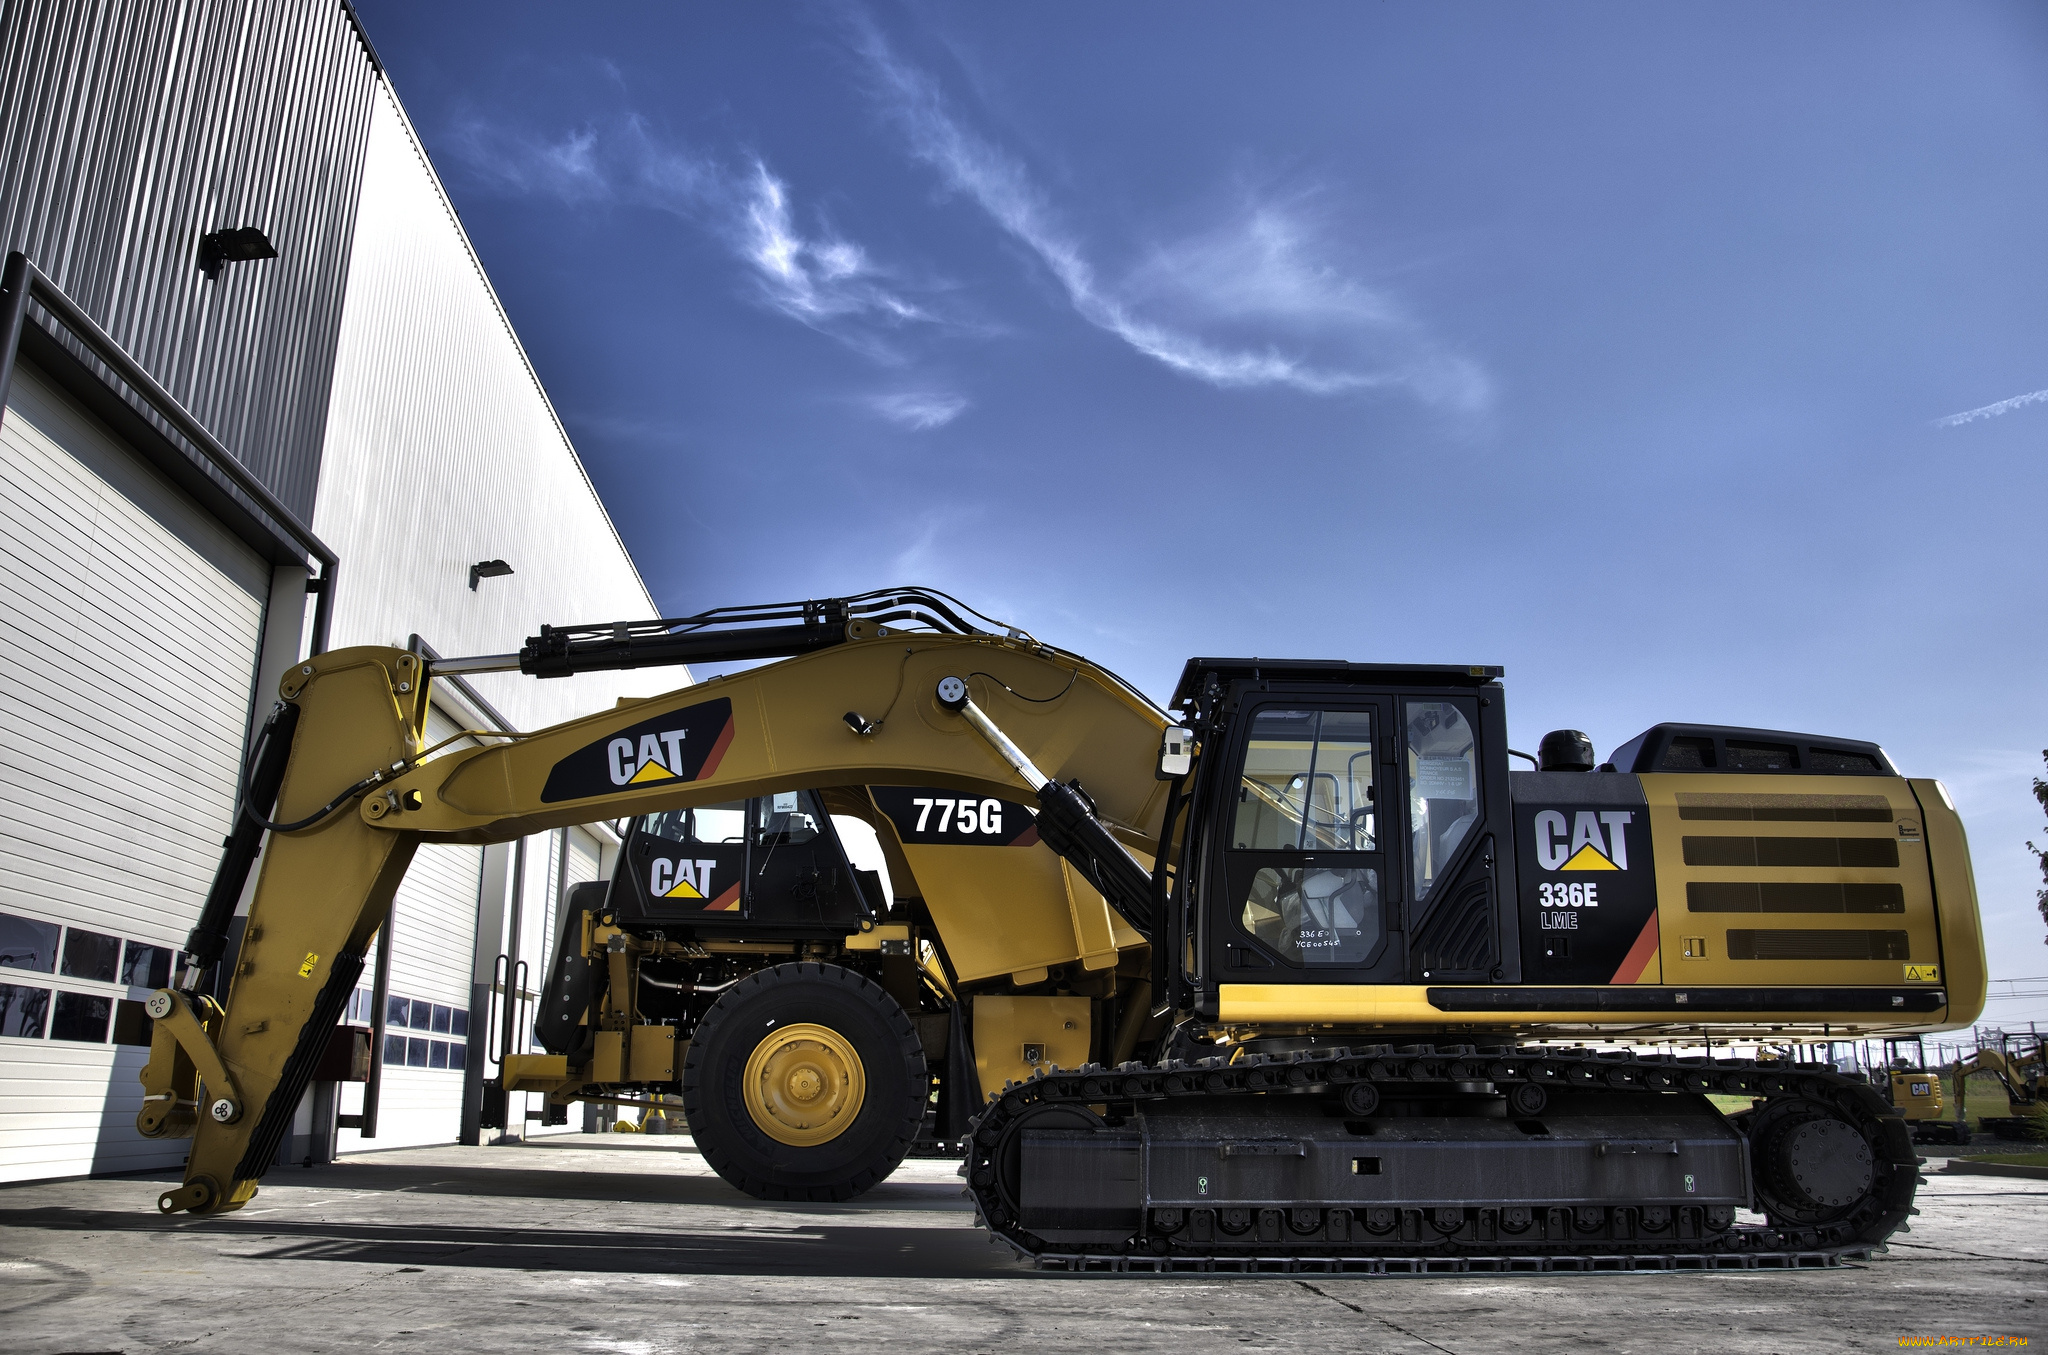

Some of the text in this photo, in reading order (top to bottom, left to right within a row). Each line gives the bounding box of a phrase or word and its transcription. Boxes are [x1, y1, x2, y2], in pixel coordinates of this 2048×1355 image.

[607, 729, 686, 786] CAT
[913, 798, 1002, 834] 775G
[1534, 809, 1632, 871] CAT
[650, 857, 717, 899] CAT
[1539, 882, 1598, 907] 336E
[1299, 930, 1324, 938] 336 E
[1540, 911, 1578, 930] LME
[1911, 1083, 1929, 1096] CAT
